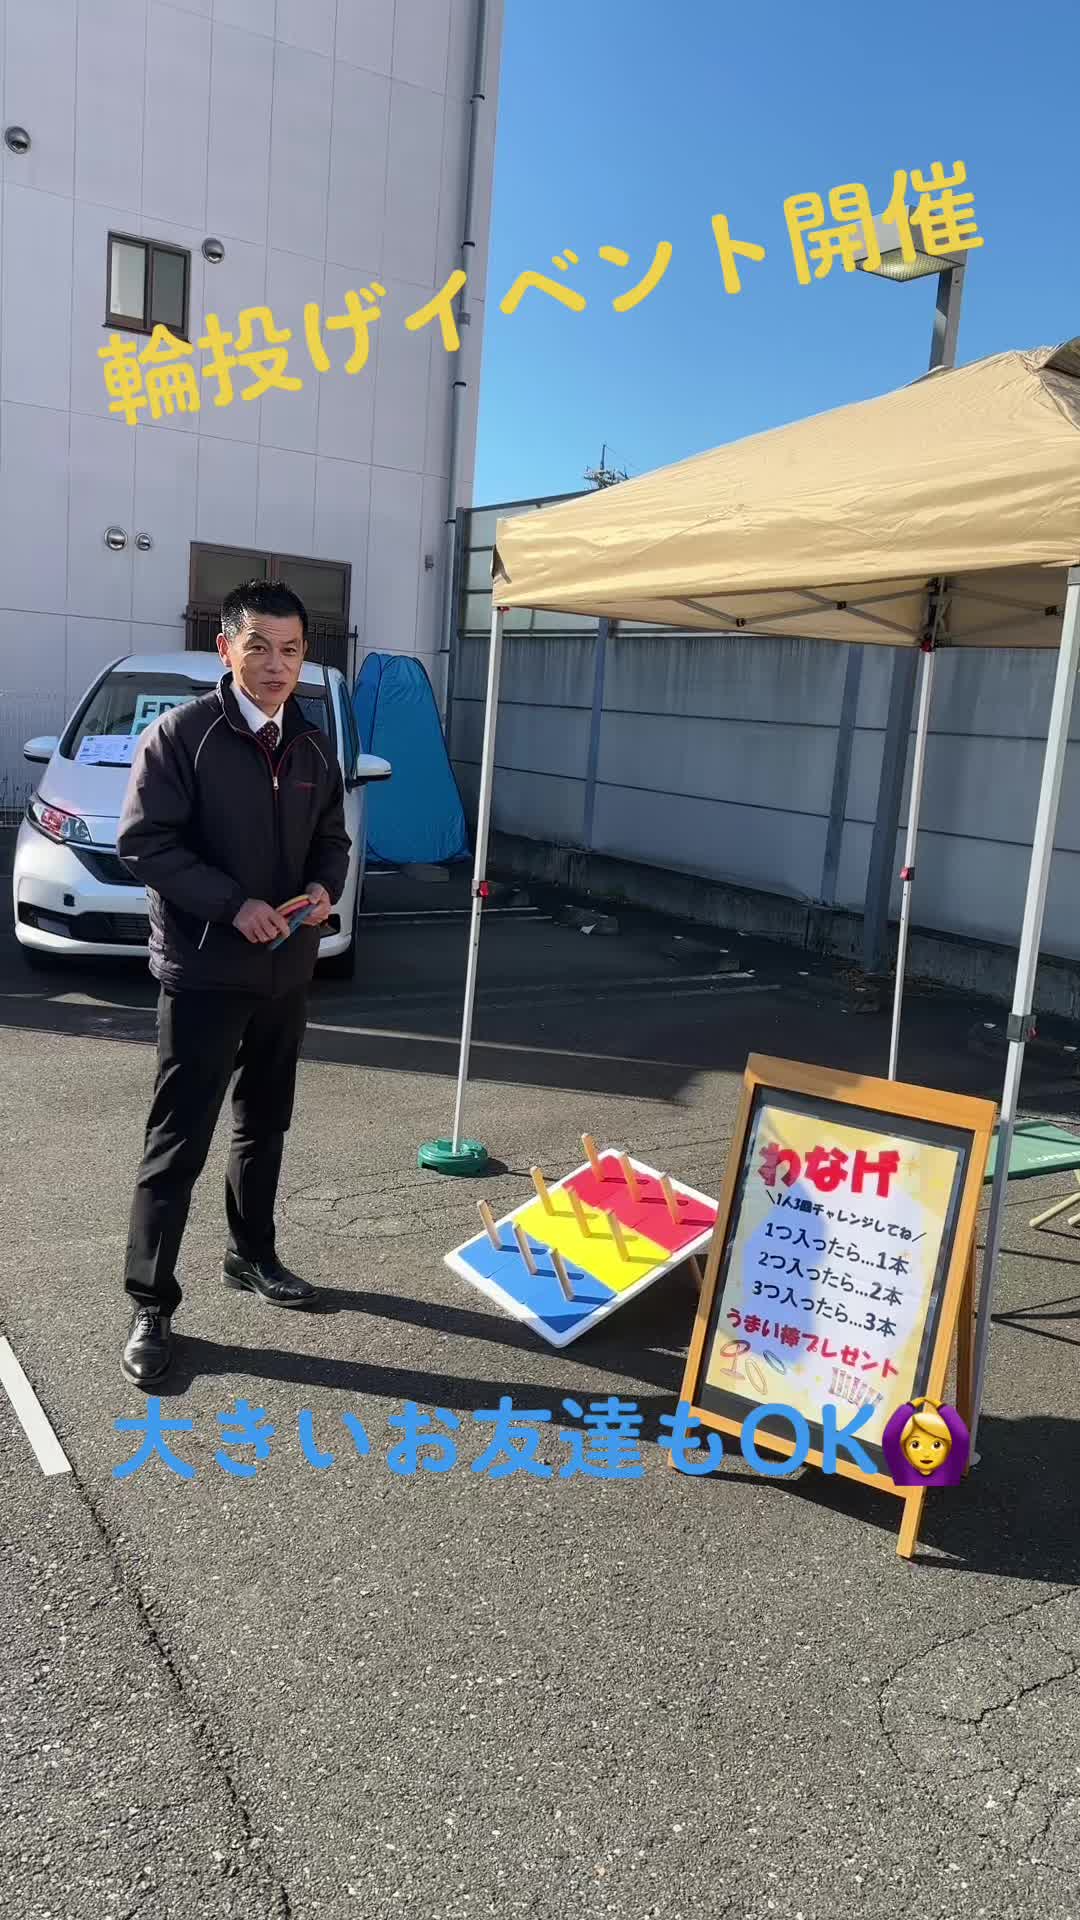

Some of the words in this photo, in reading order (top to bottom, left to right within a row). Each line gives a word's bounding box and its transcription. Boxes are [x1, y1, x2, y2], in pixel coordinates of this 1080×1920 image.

[758, 1142, 901, 1198] わなげ
[726, 1307, 899, 1378] うまい棒プレゼント
